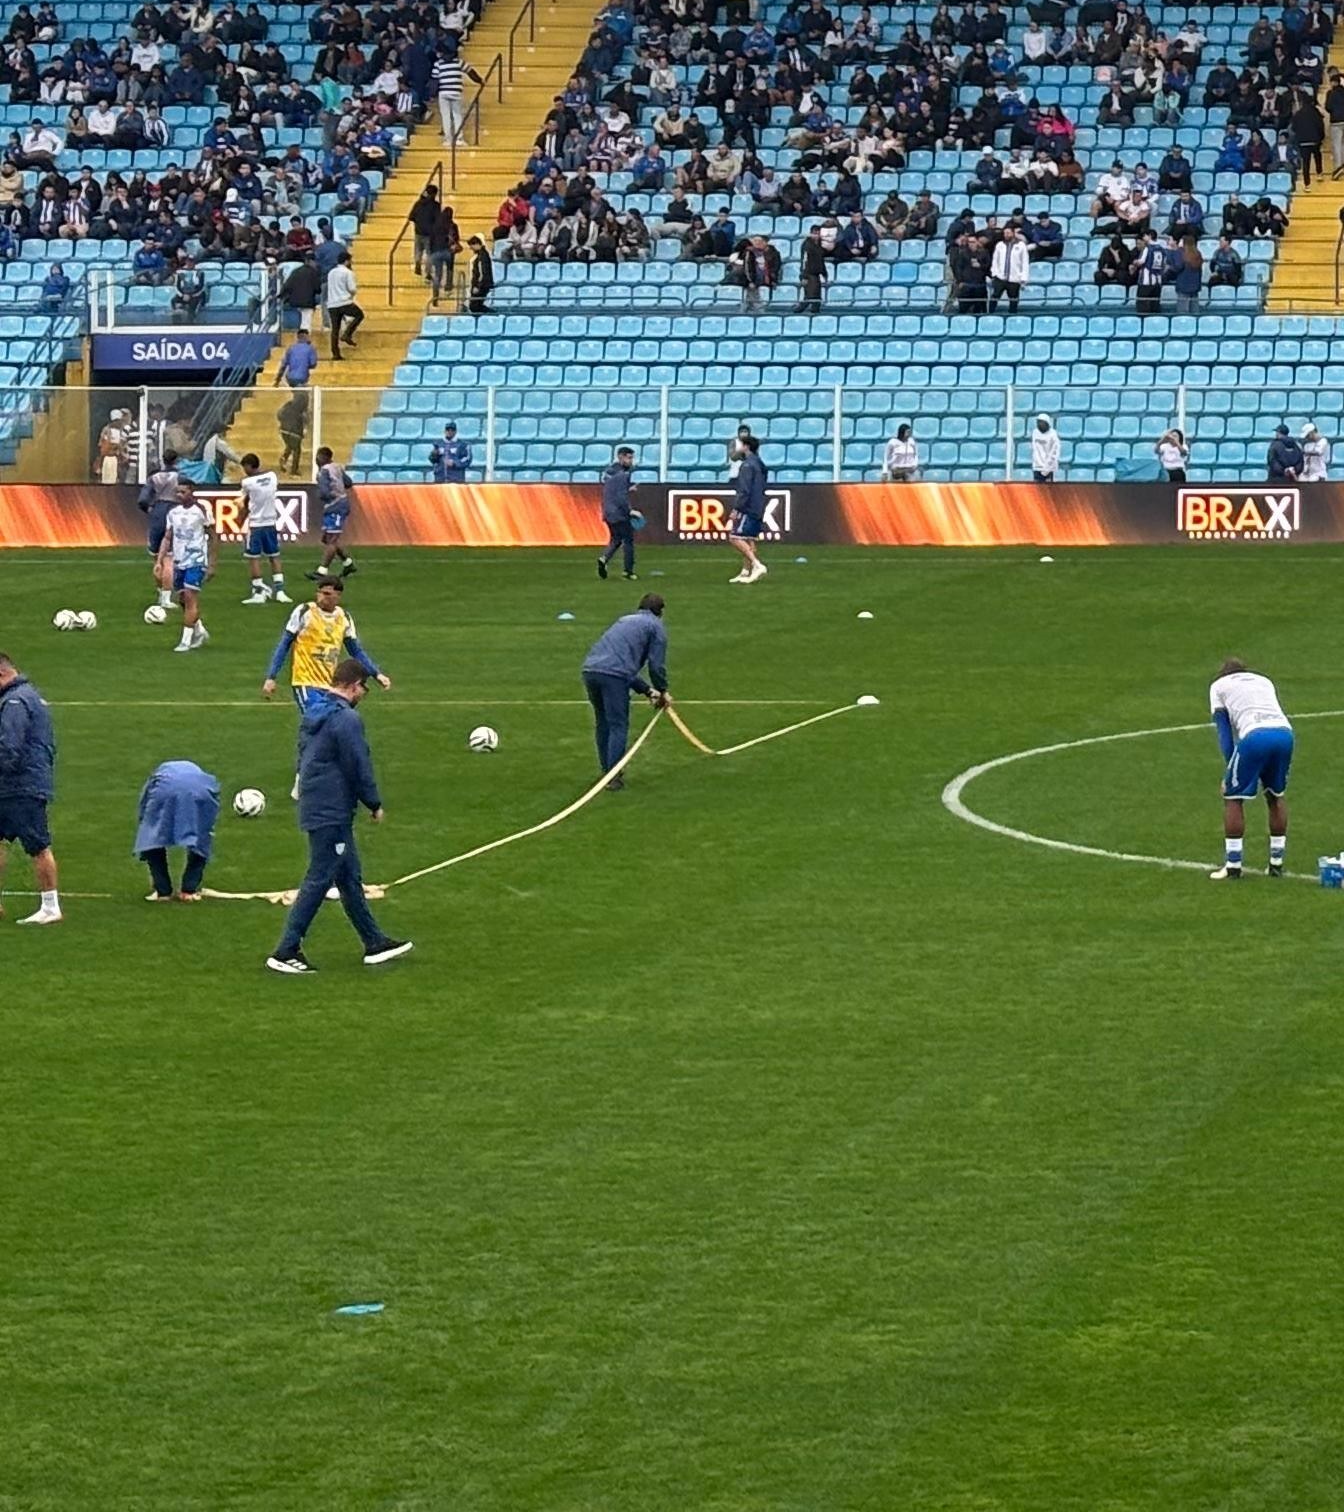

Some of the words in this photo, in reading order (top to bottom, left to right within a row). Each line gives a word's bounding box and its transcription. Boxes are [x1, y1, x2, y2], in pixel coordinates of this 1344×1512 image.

[132, 339, 196, 361] SAÍDA
[201, 342, 230, 361] 04
[680, 498, 780, 531] BRX
[1186, 495, 1292, 531] BRAX
